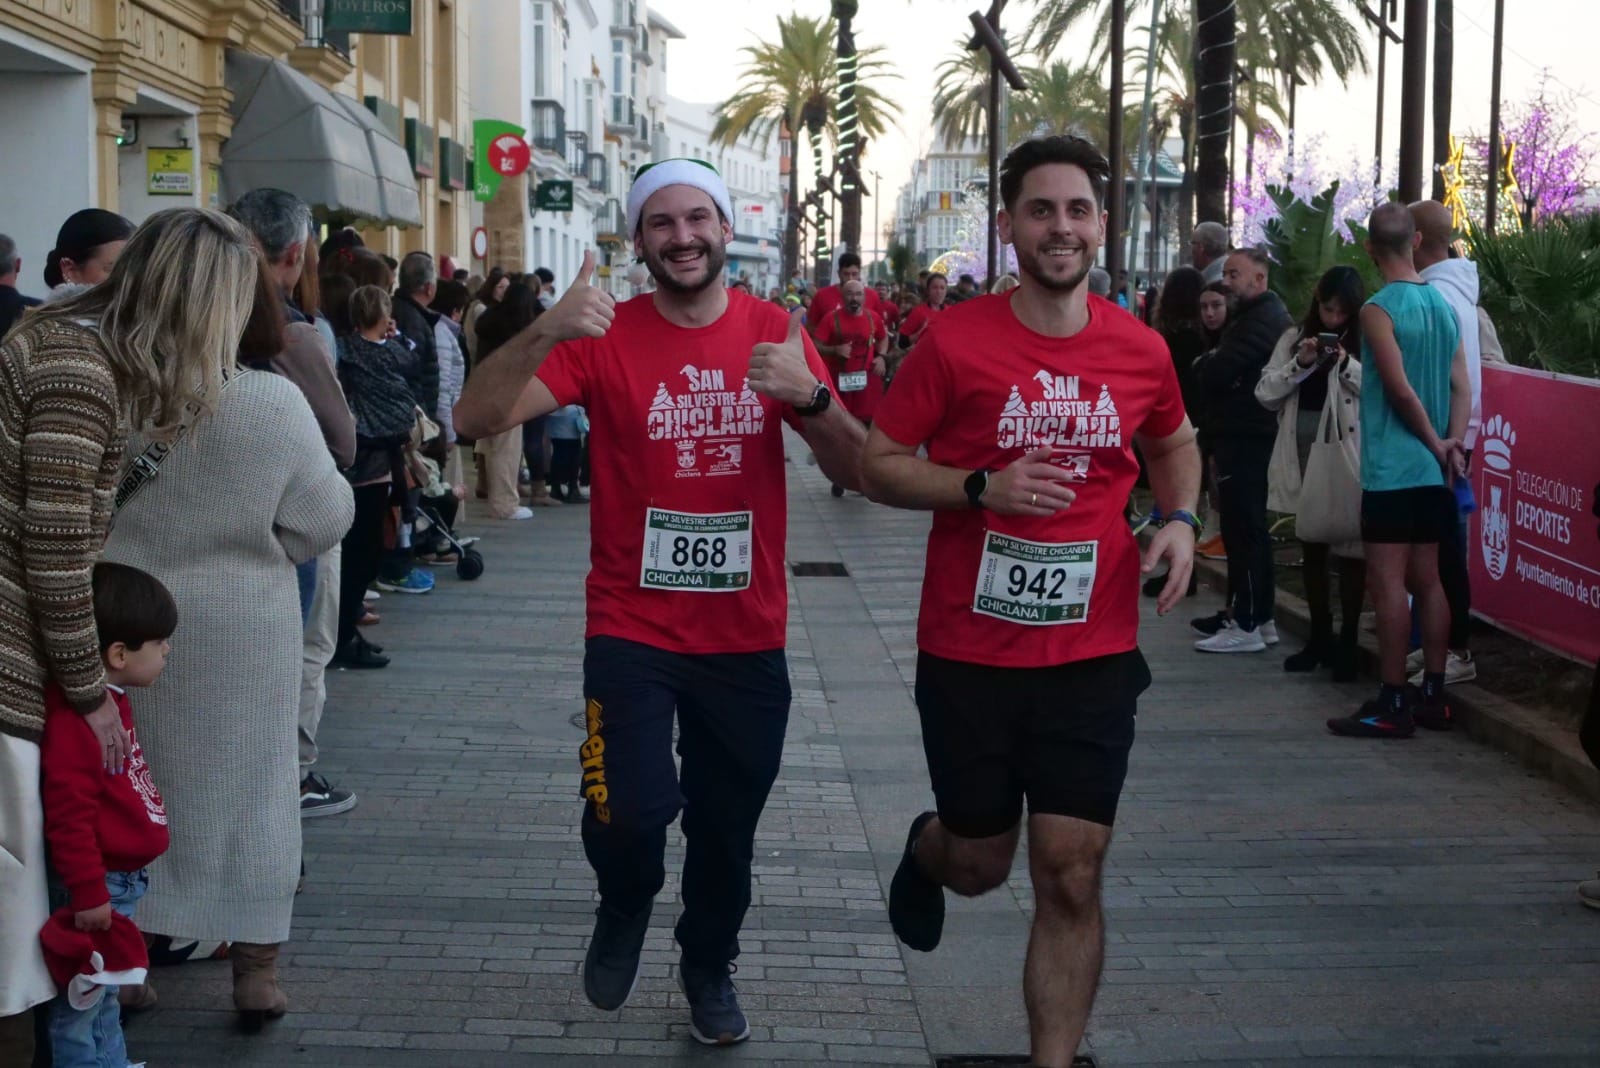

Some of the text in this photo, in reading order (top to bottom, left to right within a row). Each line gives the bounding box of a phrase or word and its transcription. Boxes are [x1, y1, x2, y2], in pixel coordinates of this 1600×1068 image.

[332, 0, 406, 14] JOYEROS
[689, 369, 724, 392] SAN
[1043, 376, 1080, 400] SAN
[677, 392, 737, 408] SILVESTRE
[1031, 401, 1092, 417] SILVESTRE
[648, 405, 765, 440] CHICLANA
[997, 415, 1121, 448] CHICLANA
[1516, 470, 1582, 512] DELEGACIÓN DE
[652, 512, 748, 526] SAN SILVESTRE CHICLANERA
[1515, 500, 1570, 544] DEPORTES
[671, 536, 727, 568] 868
[991, 535, 1091, 555] SAN SILVESTRE CHICLANERA
[646, 571, 703, 584] CHICLANA
[1007, 564, 1067, 600] 942
[1516, 554, 1575, 598] Ayuntamiento
[1576, 578, 1589, 604] de
[979, 598, 1039, 619] CHICLANA
